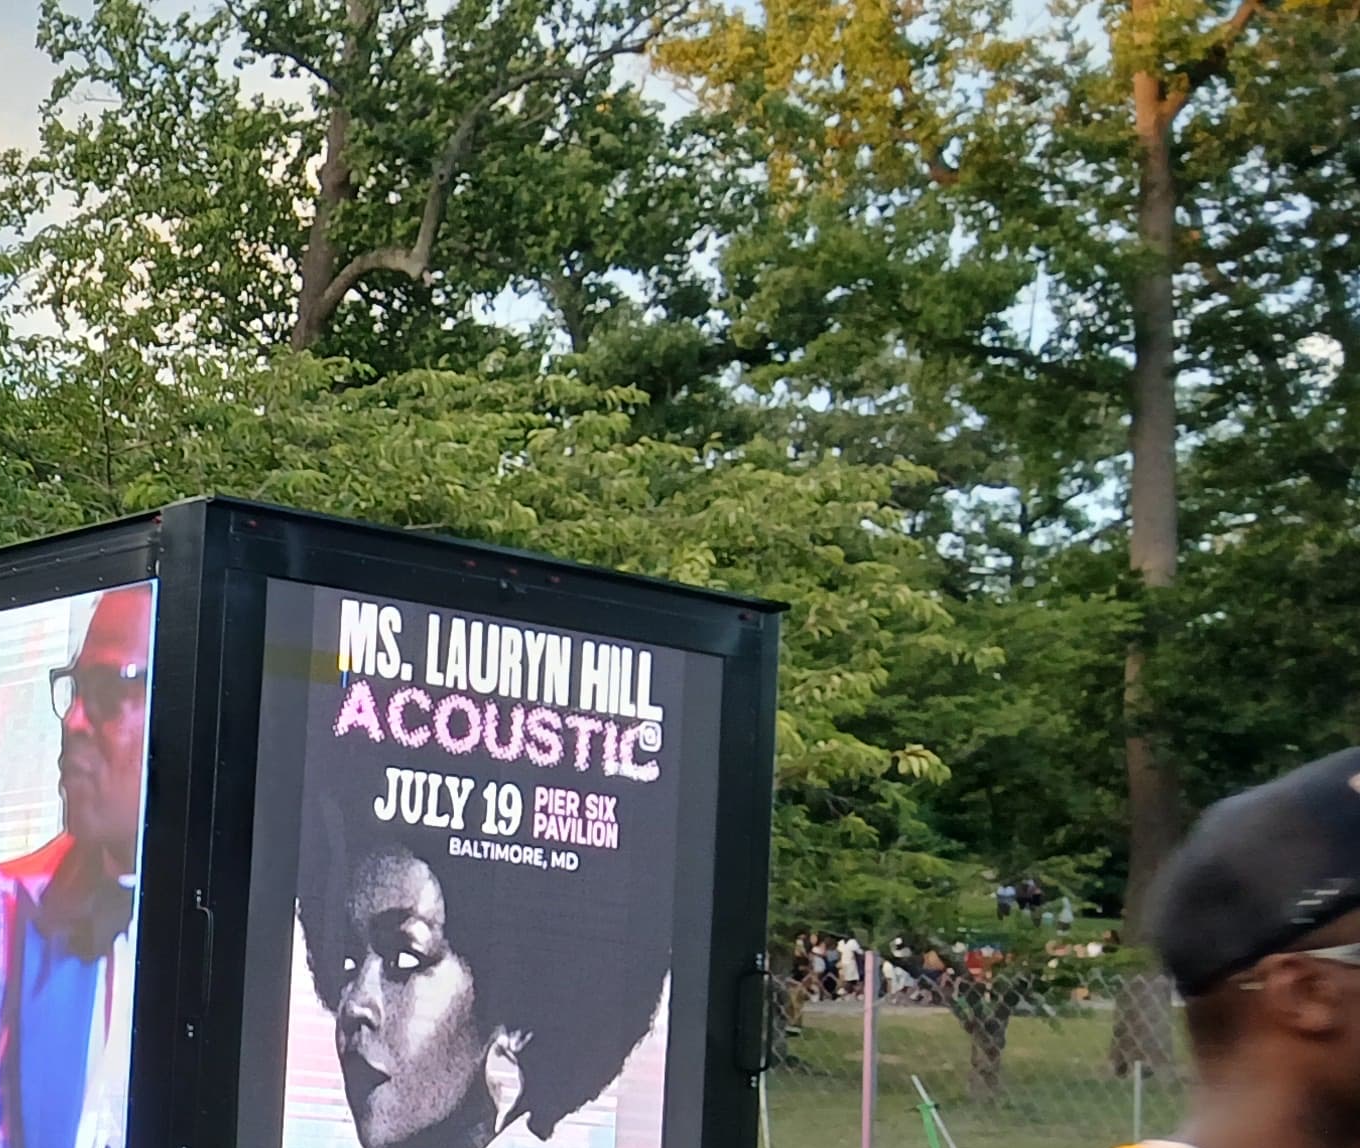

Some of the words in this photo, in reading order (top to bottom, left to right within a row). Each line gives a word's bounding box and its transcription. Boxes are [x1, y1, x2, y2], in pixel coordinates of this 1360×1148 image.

[338, 598, 413, 681] MS.
[426, 613, 572, 707] LAURYN
[579, 640, 664, 723] HILL
[333, 679, 662, 783] ACOUSTIC
[374, 767, 475, 830] JULY
[482, 782, 523, 836] 19
[534, 786, 580, 818] PIER
[585, 793, 617, 823] SIX
[449, 836, 548, 870] BALTIMORE,
[551, 851, 579, 872] MD
[532, 813, 619, 849] PAVILION
